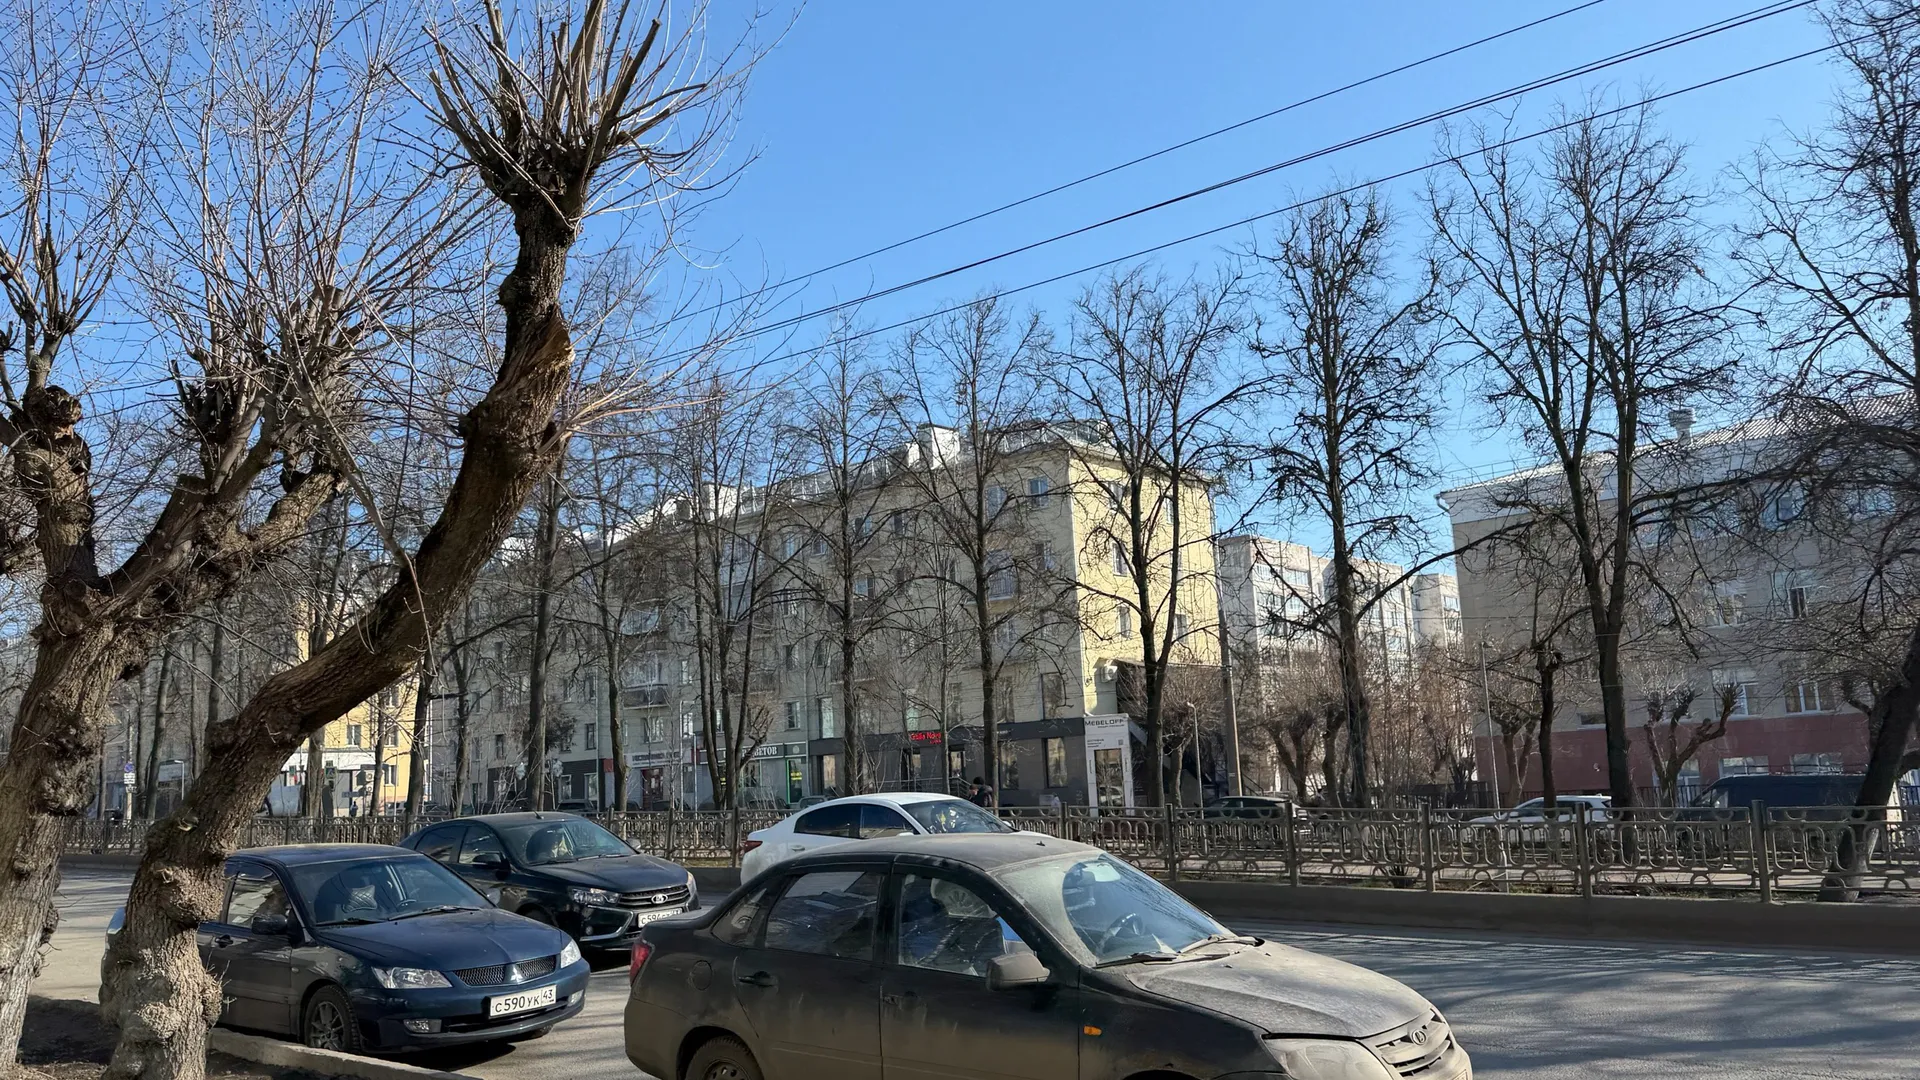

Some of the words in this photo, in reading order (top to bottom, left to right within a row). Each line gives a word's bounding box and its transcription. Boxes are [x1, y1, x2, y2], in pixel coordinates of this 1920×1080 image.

[751, 746, 777, 758] ВЕТОВ
[495, 995, 540, 1013] С590УК
[543, 989, 553, 1000] 43
